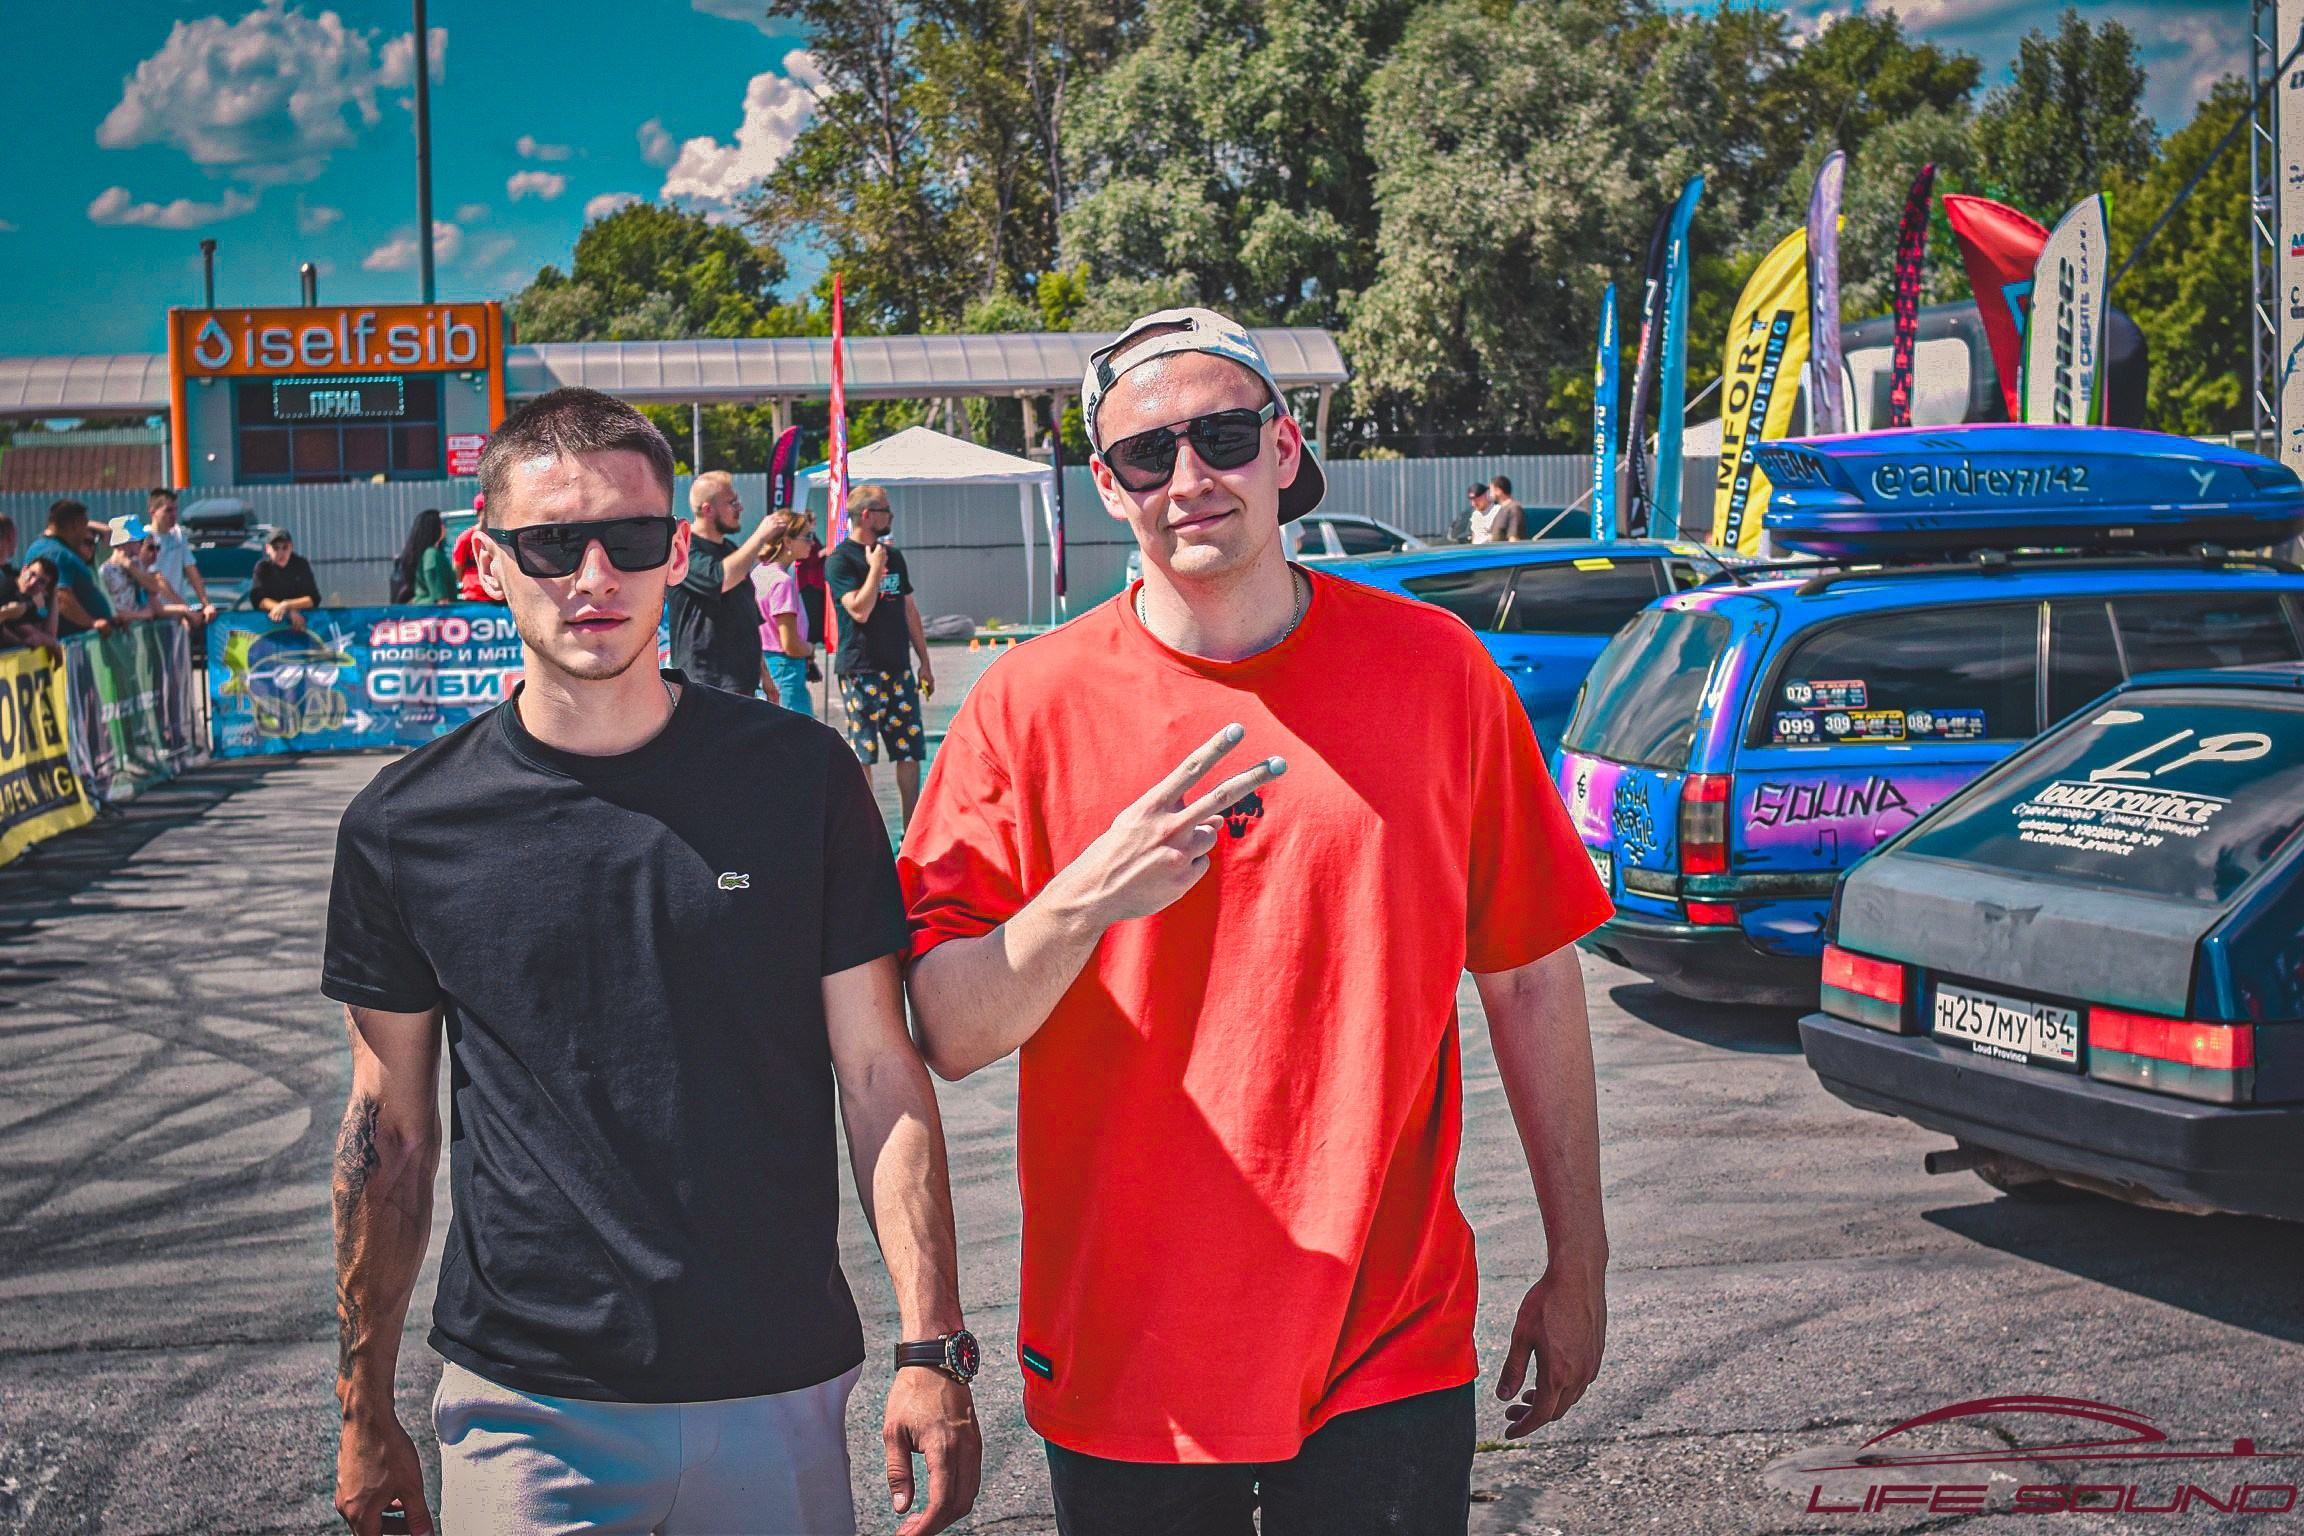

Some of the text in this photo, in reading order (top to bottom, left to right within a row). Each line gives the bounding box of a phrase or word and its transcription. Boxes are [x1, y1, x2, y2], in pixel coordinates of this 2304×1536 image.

[244, 310, 478, 367] iself.sib
[372, 647, 524, 662] ПОДБОР И МАТ
[367, 668, 525, 702] СИБИ
[1786, 686, 1812, 702] 079
[1779, 718, 1815, 734] 099
[1825, 716, 1851, 732] 309
[1907, 713, 1933, 730] 082
[2034, 1008, 2071, 1045] 154
